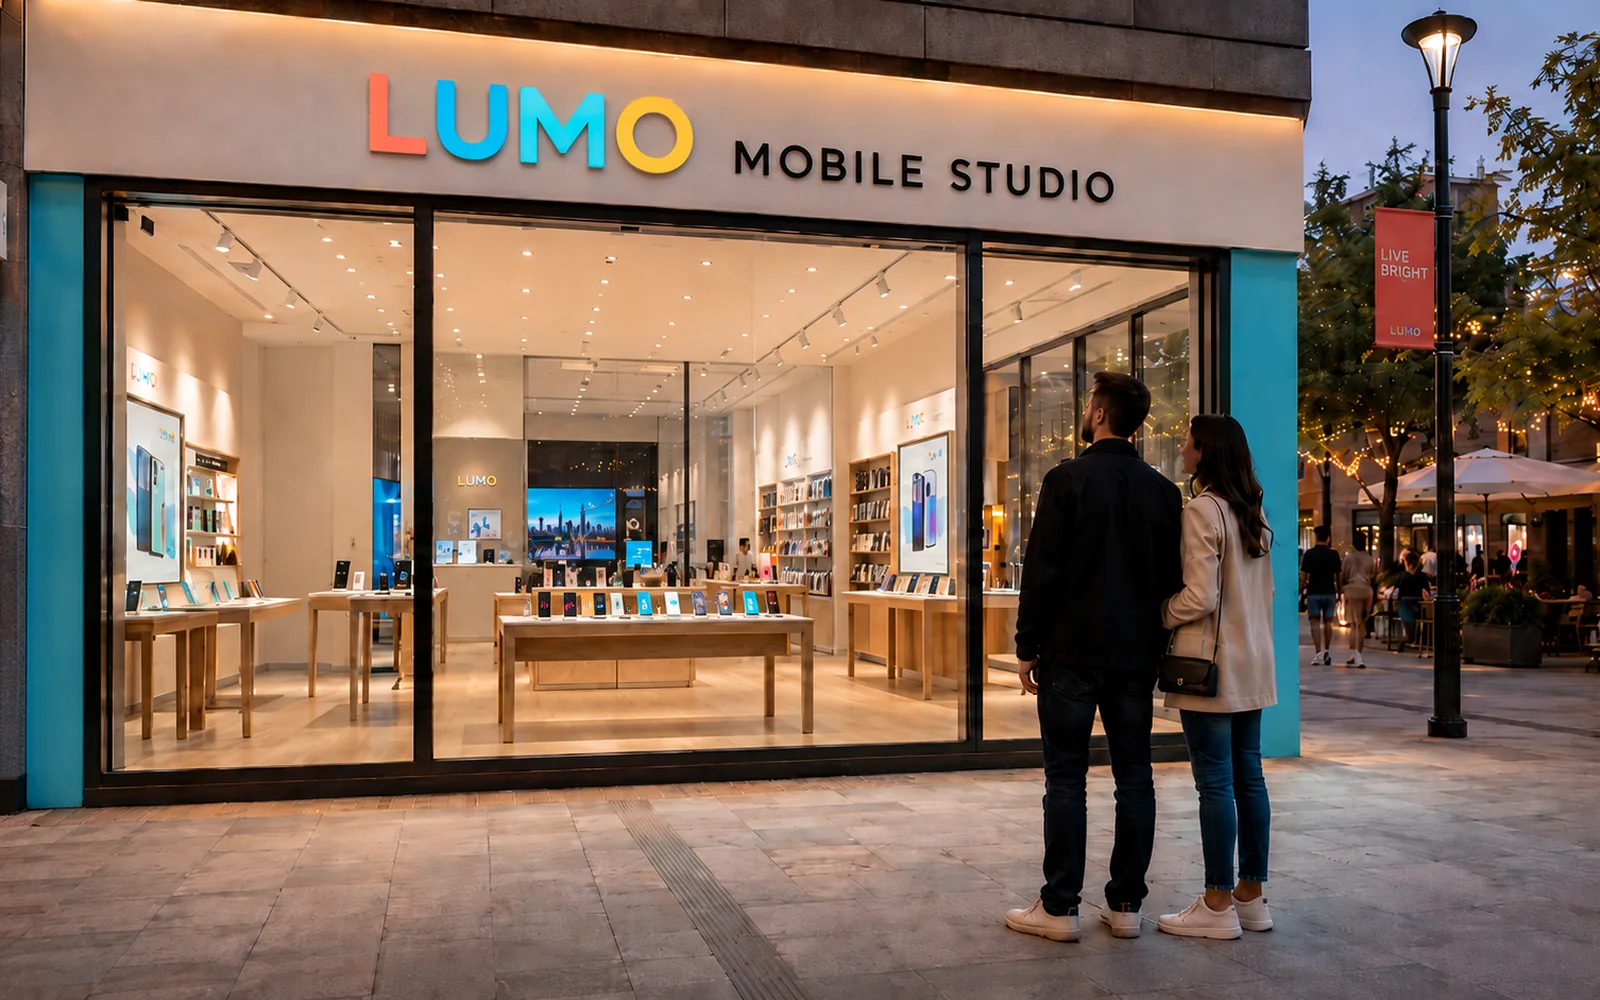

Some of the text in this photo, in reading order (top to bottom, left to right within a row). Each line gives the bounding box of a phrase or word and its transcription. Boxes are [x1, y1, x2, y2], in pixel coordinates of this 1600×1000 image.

[368, 73, 1115, 203] LUMO MOBILE STUDIO
[1381, 248, 1409, 263] LIVE
[1381, 264, 1428, 279] BRIGHT
[1390, 326, 1421, 337] LUMO
[457, 475, 497, 487] LUMO
